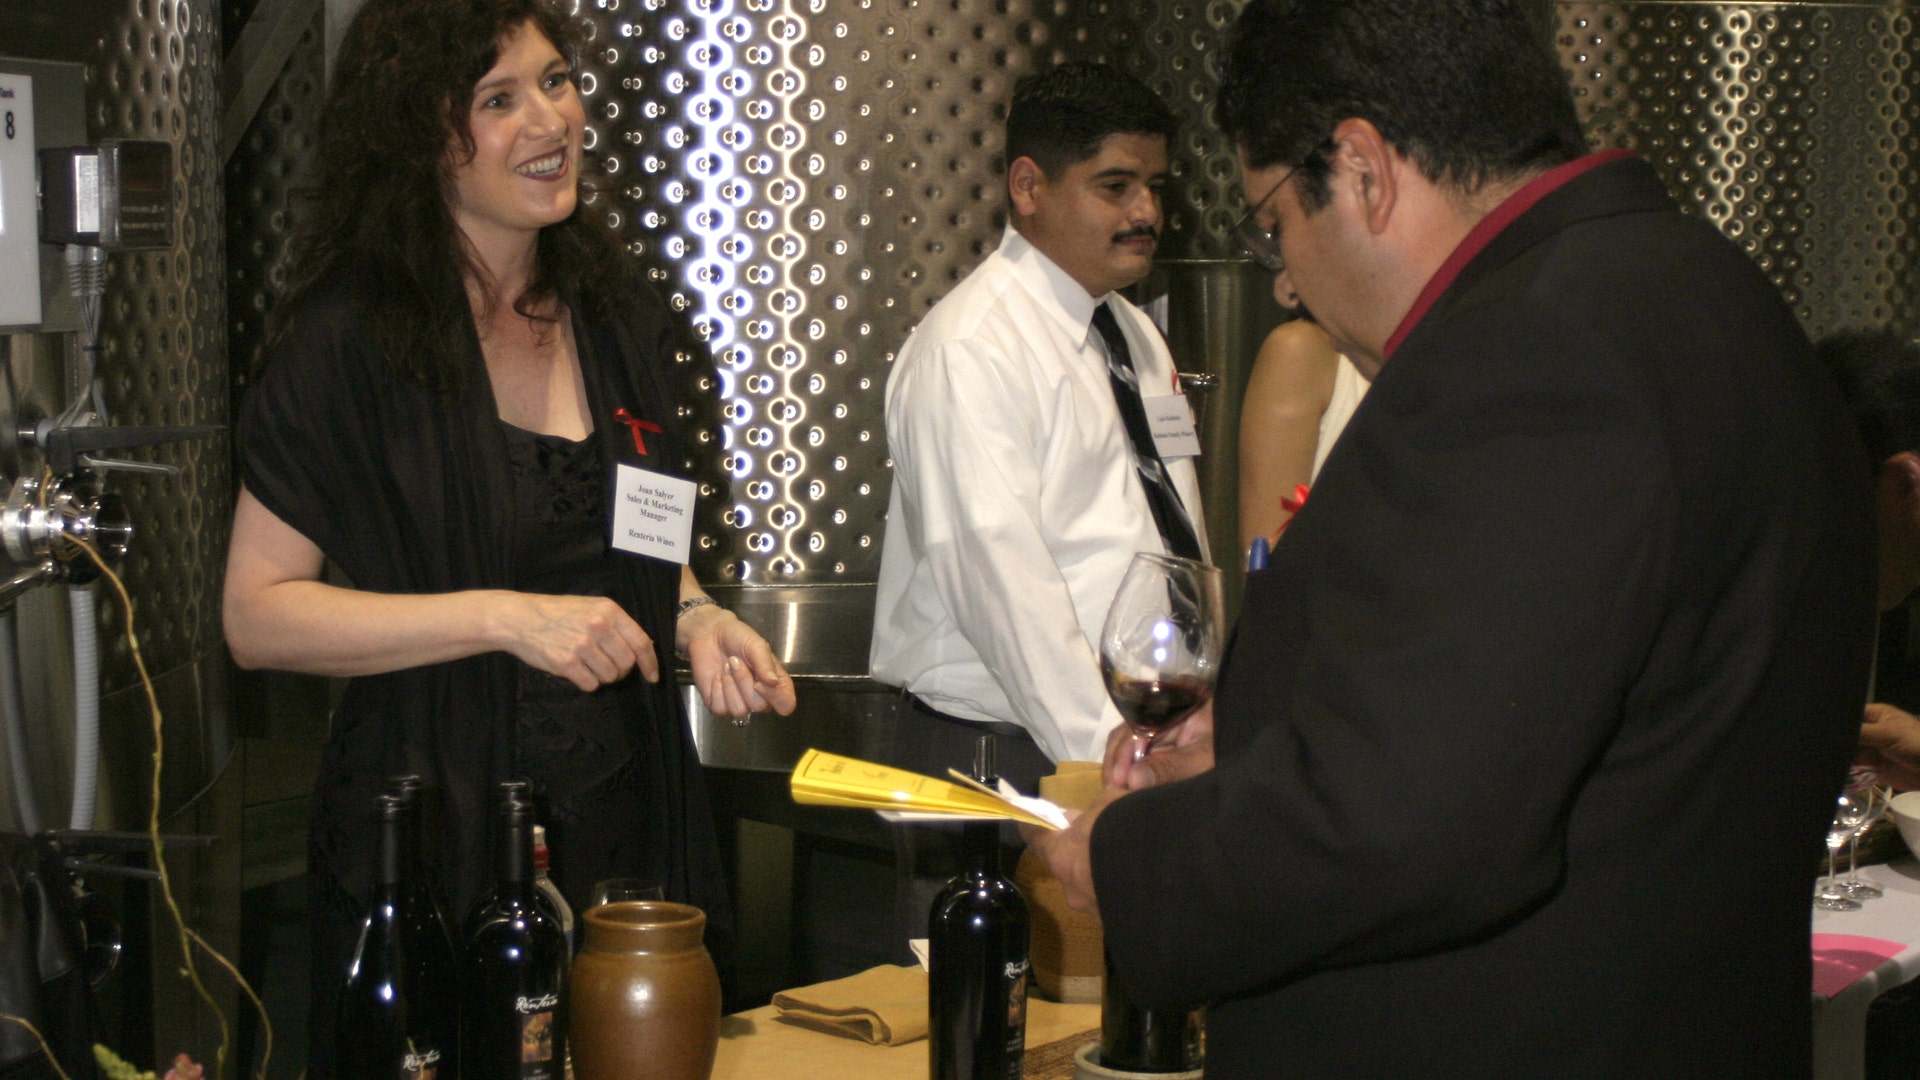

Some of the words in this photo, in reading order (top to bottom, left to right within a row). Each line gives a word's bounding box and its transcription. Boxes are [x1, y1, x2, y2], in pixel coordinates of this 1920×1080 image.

[5, 110, 15, 140] 8
[638, 484, 653, 495] Joan
[654, 488, 674, 501] Salyer
[626, 493, 642, 505] Sales
[643, 497, 649, 506] &
[651, 500, 684, 515] Marketing
[640, 508, 667, 522] Manager
[628, 528, 655, 542] Renteria
[656, 534, 675, 547] Wines
